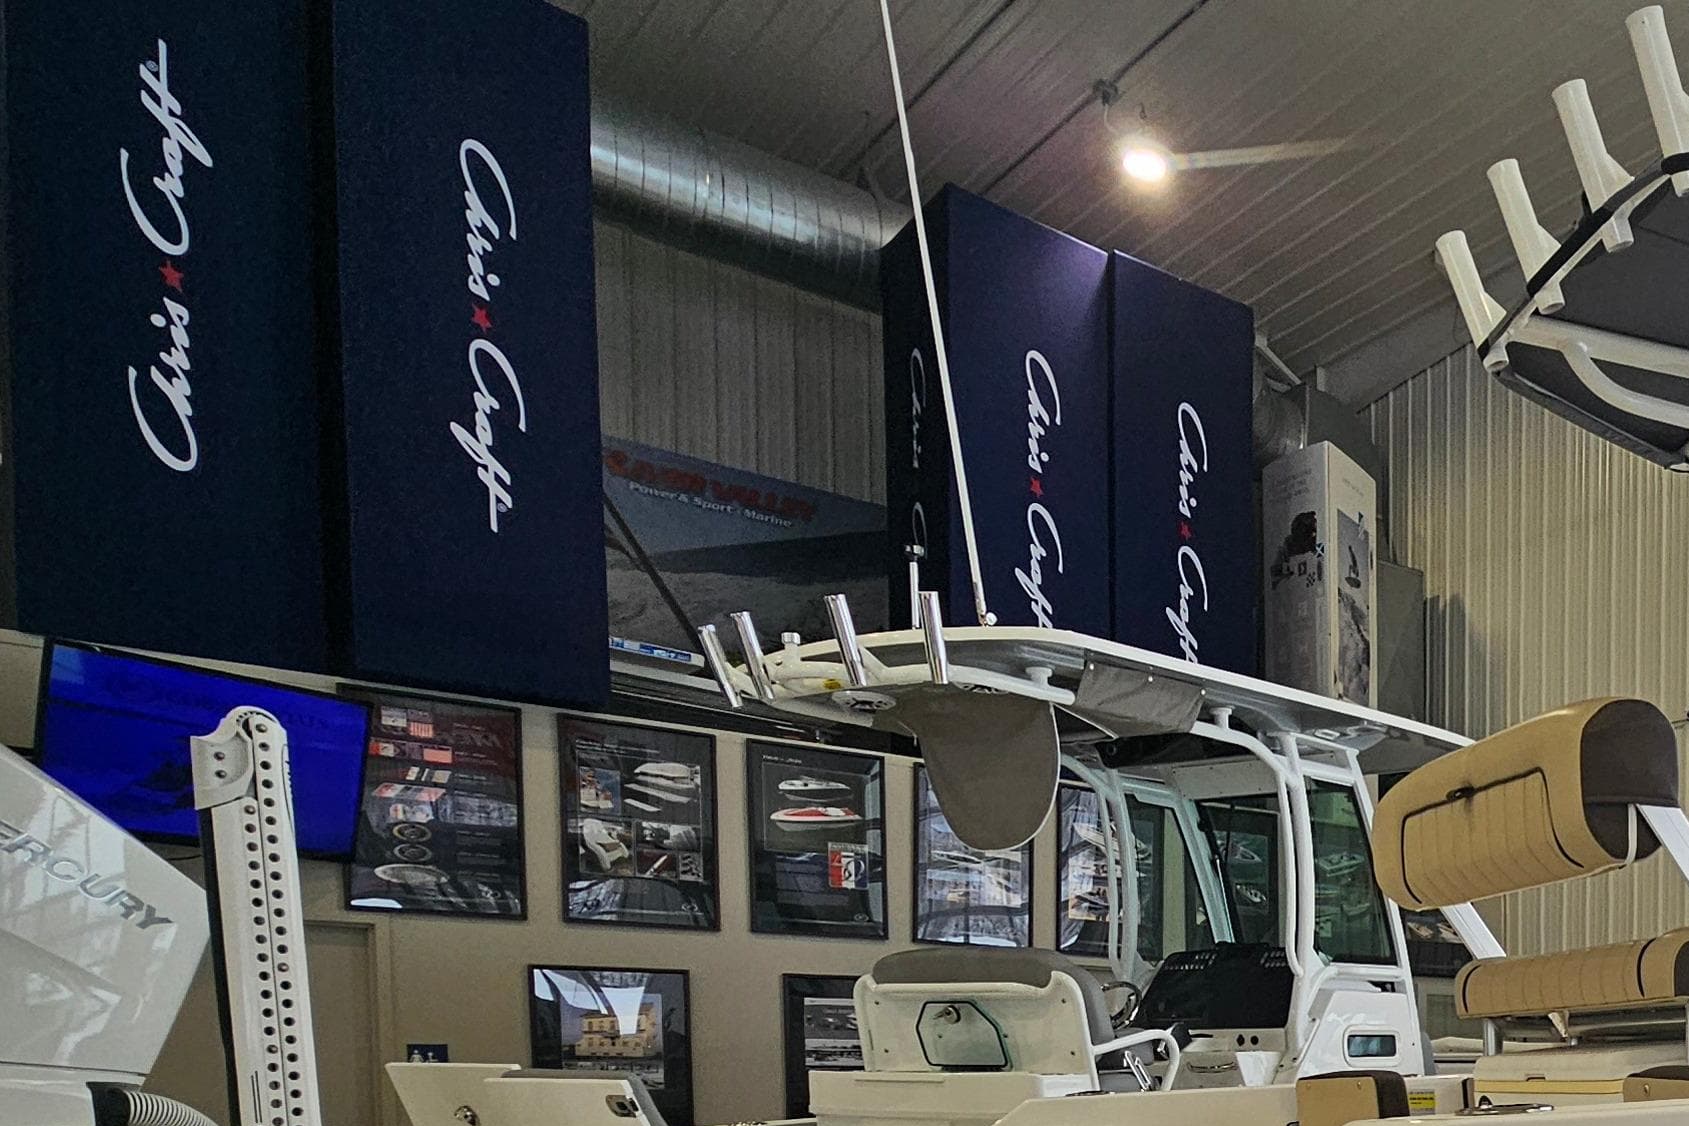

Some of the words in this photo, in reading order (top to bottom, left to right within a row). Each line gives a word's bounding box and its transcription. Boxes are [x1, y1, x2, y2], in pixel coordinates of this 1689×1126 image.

[1025, 350, 1061, 474] Chris
[1177, 402, 1208, 519] Chris
[693, 497, 734, 514] Sport
[743, 507, 793, 528] Marine
